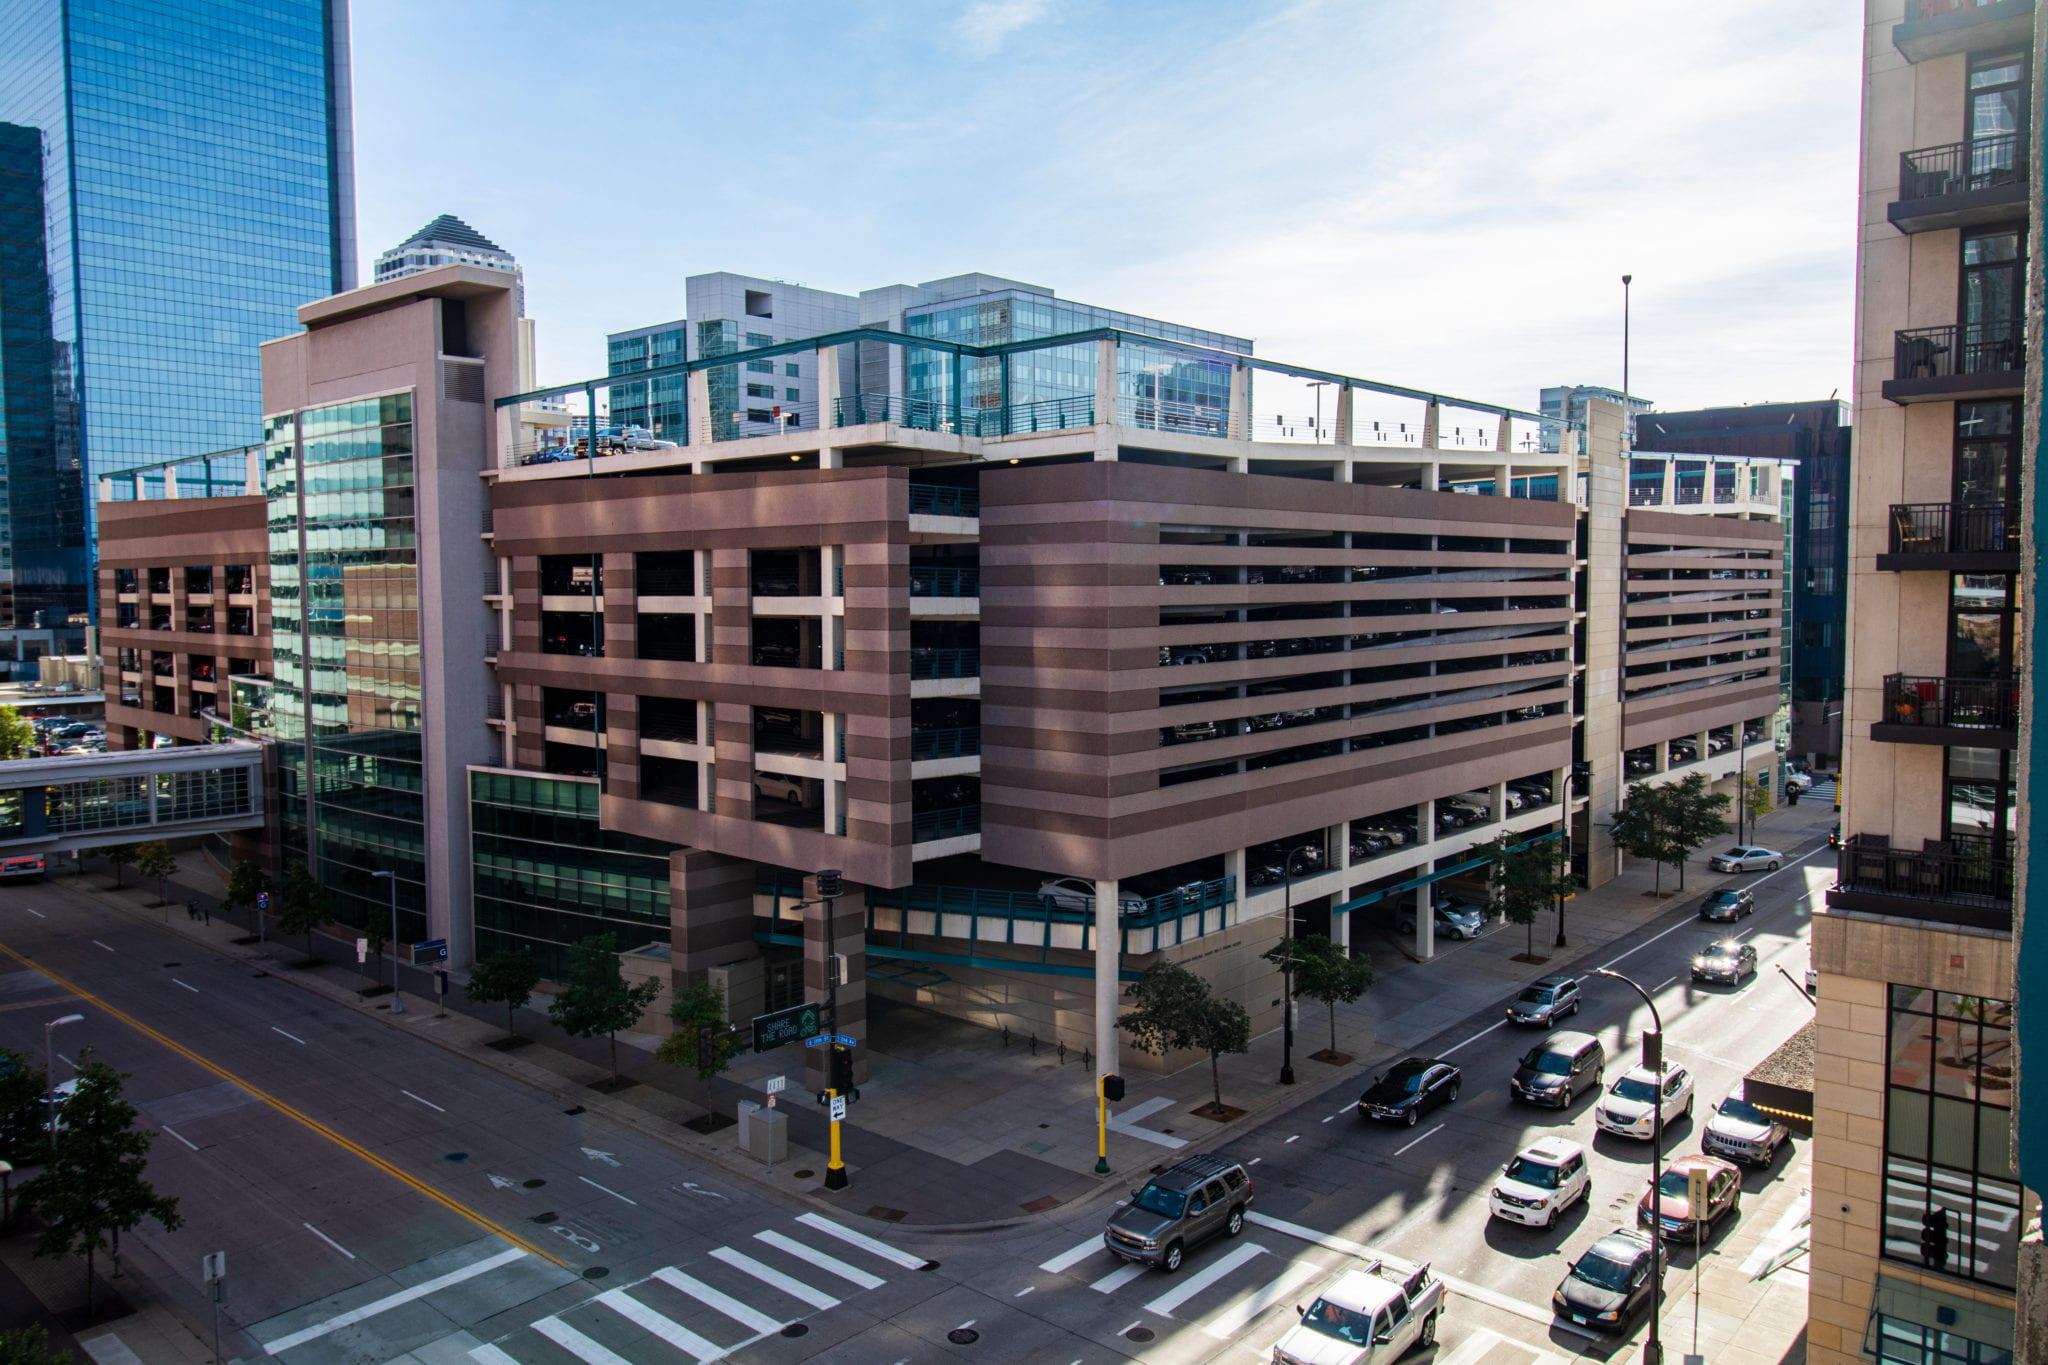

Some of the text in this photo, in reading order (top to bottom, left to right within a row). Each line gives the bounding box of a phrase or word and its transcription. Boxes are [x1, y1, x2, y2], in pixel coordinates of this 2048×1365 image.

[440, 948, 446, 956] G
[767, 1018, 790, 1033] SHARE
[760, 1025, 798, 1043] THE ROAD
[833, 1097, 843, 1105] ONE
